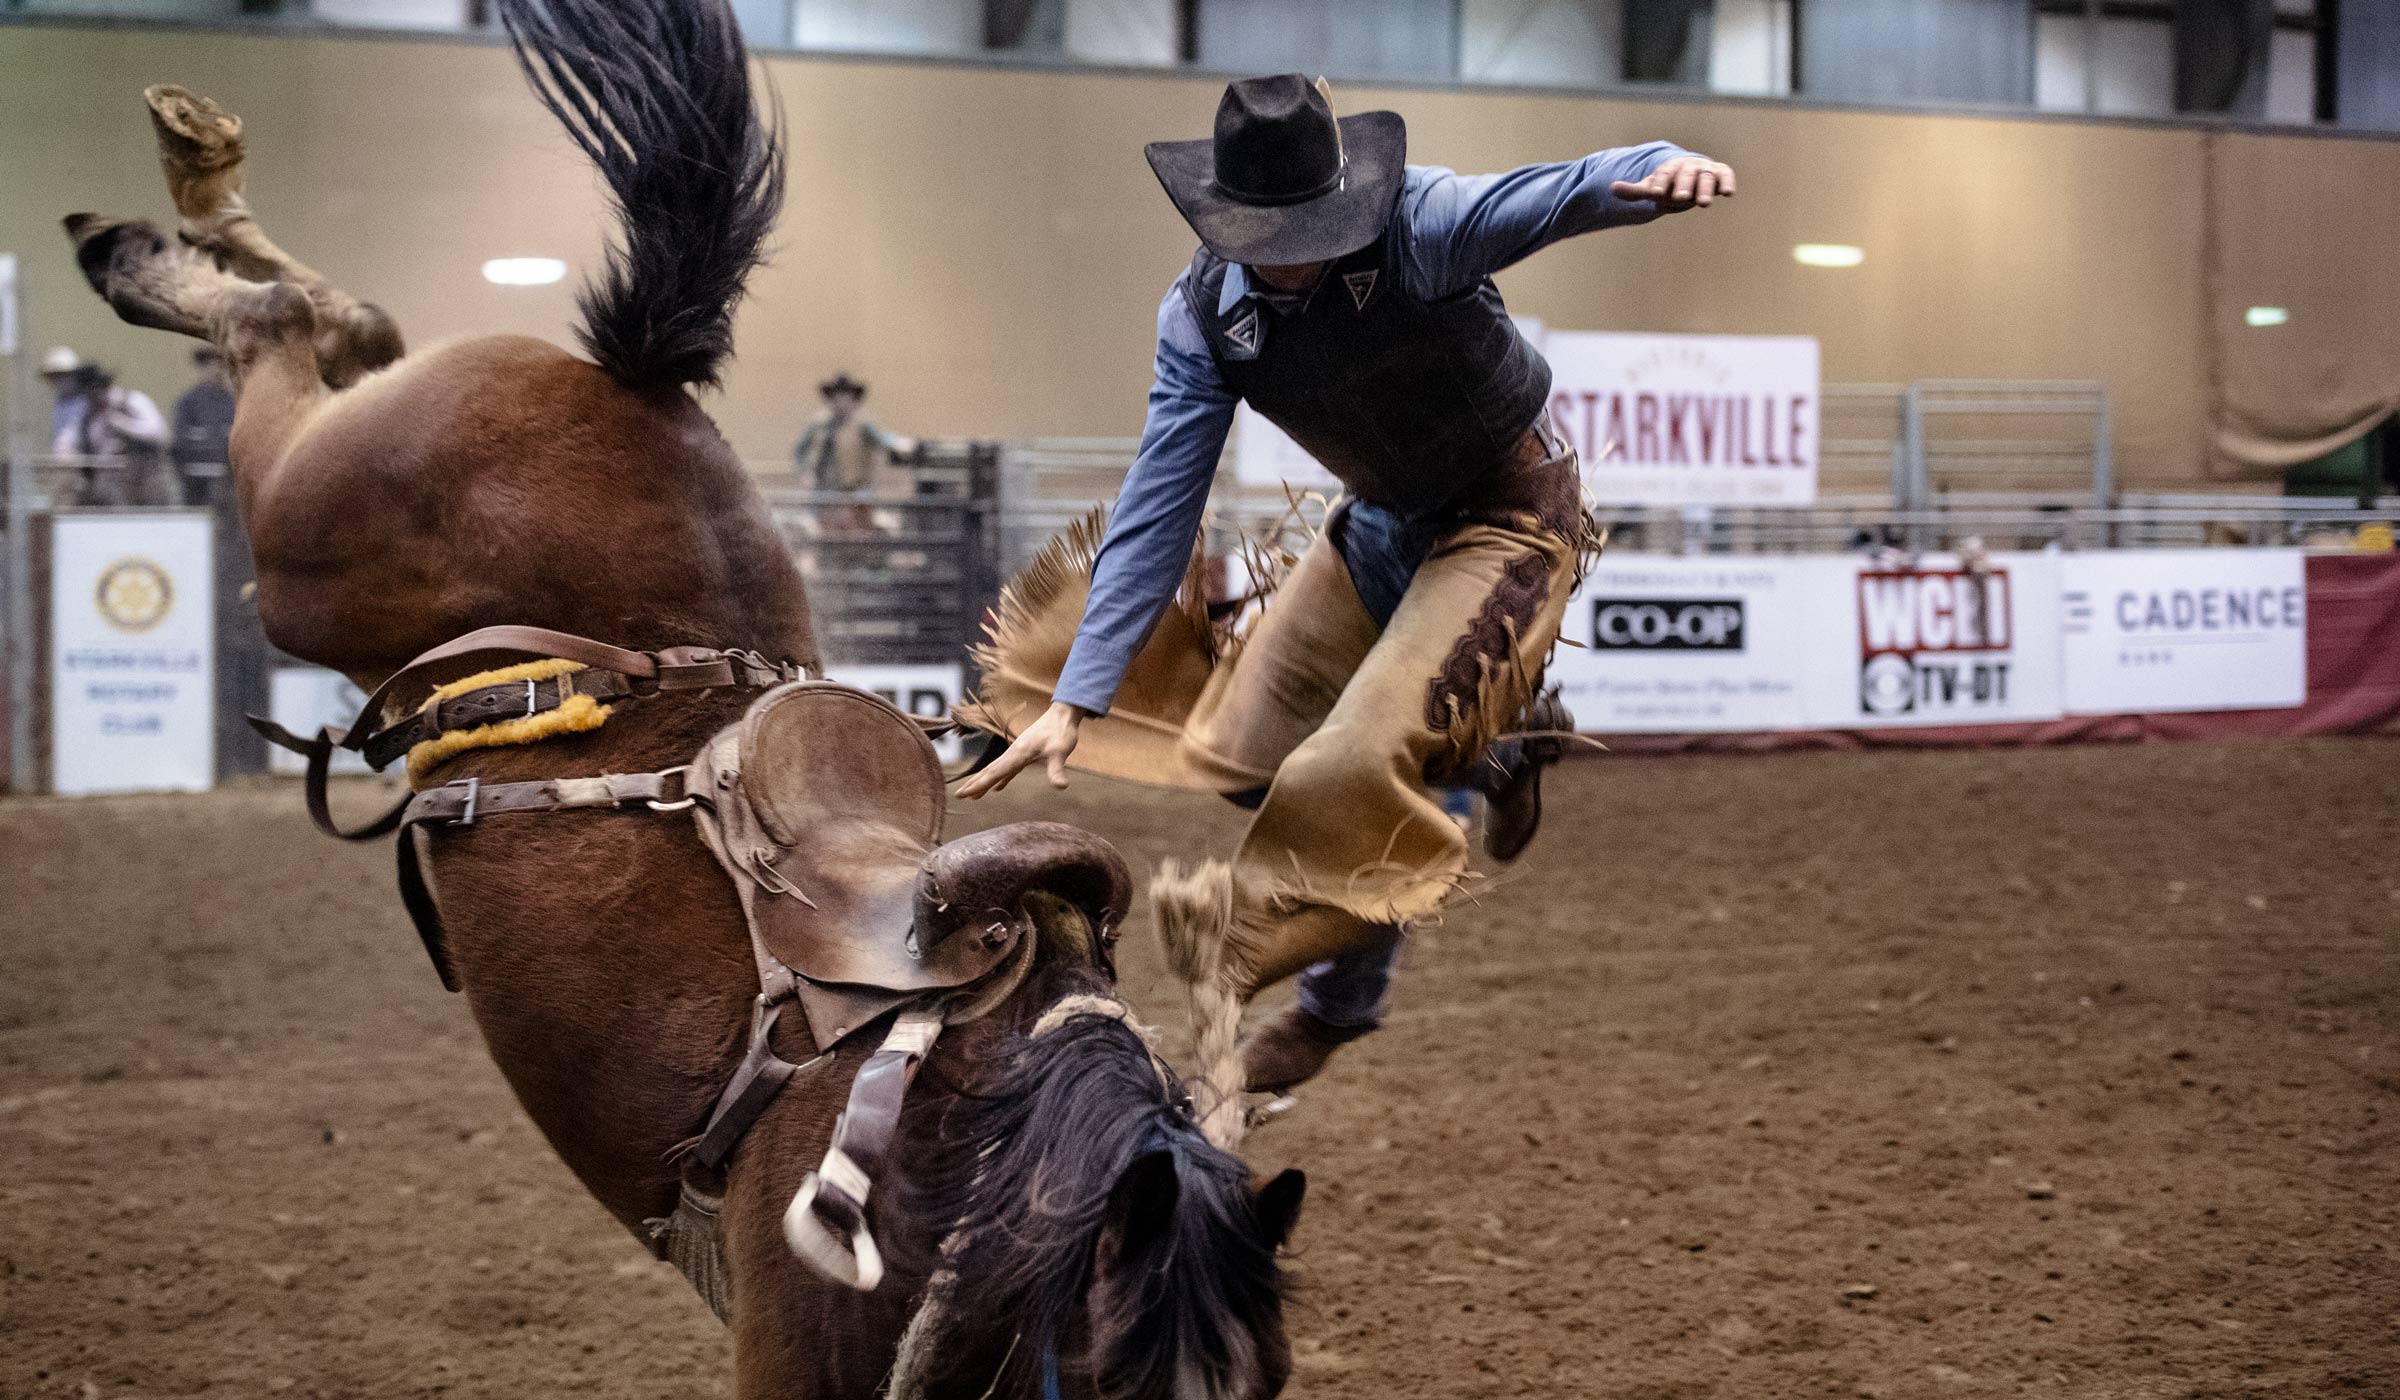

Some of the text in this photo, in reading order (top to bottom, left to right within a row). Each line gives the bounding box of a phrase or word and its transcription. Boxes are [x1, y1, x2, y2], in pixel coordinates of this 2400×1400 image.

[1551, 392, 1808, 466] STARKVILLE
[1597, 604, 1741, 646] CO-OP
[2115, 587, 2301, 633] CADENCE
[1915, 663, 2009, 703] TV-DT
